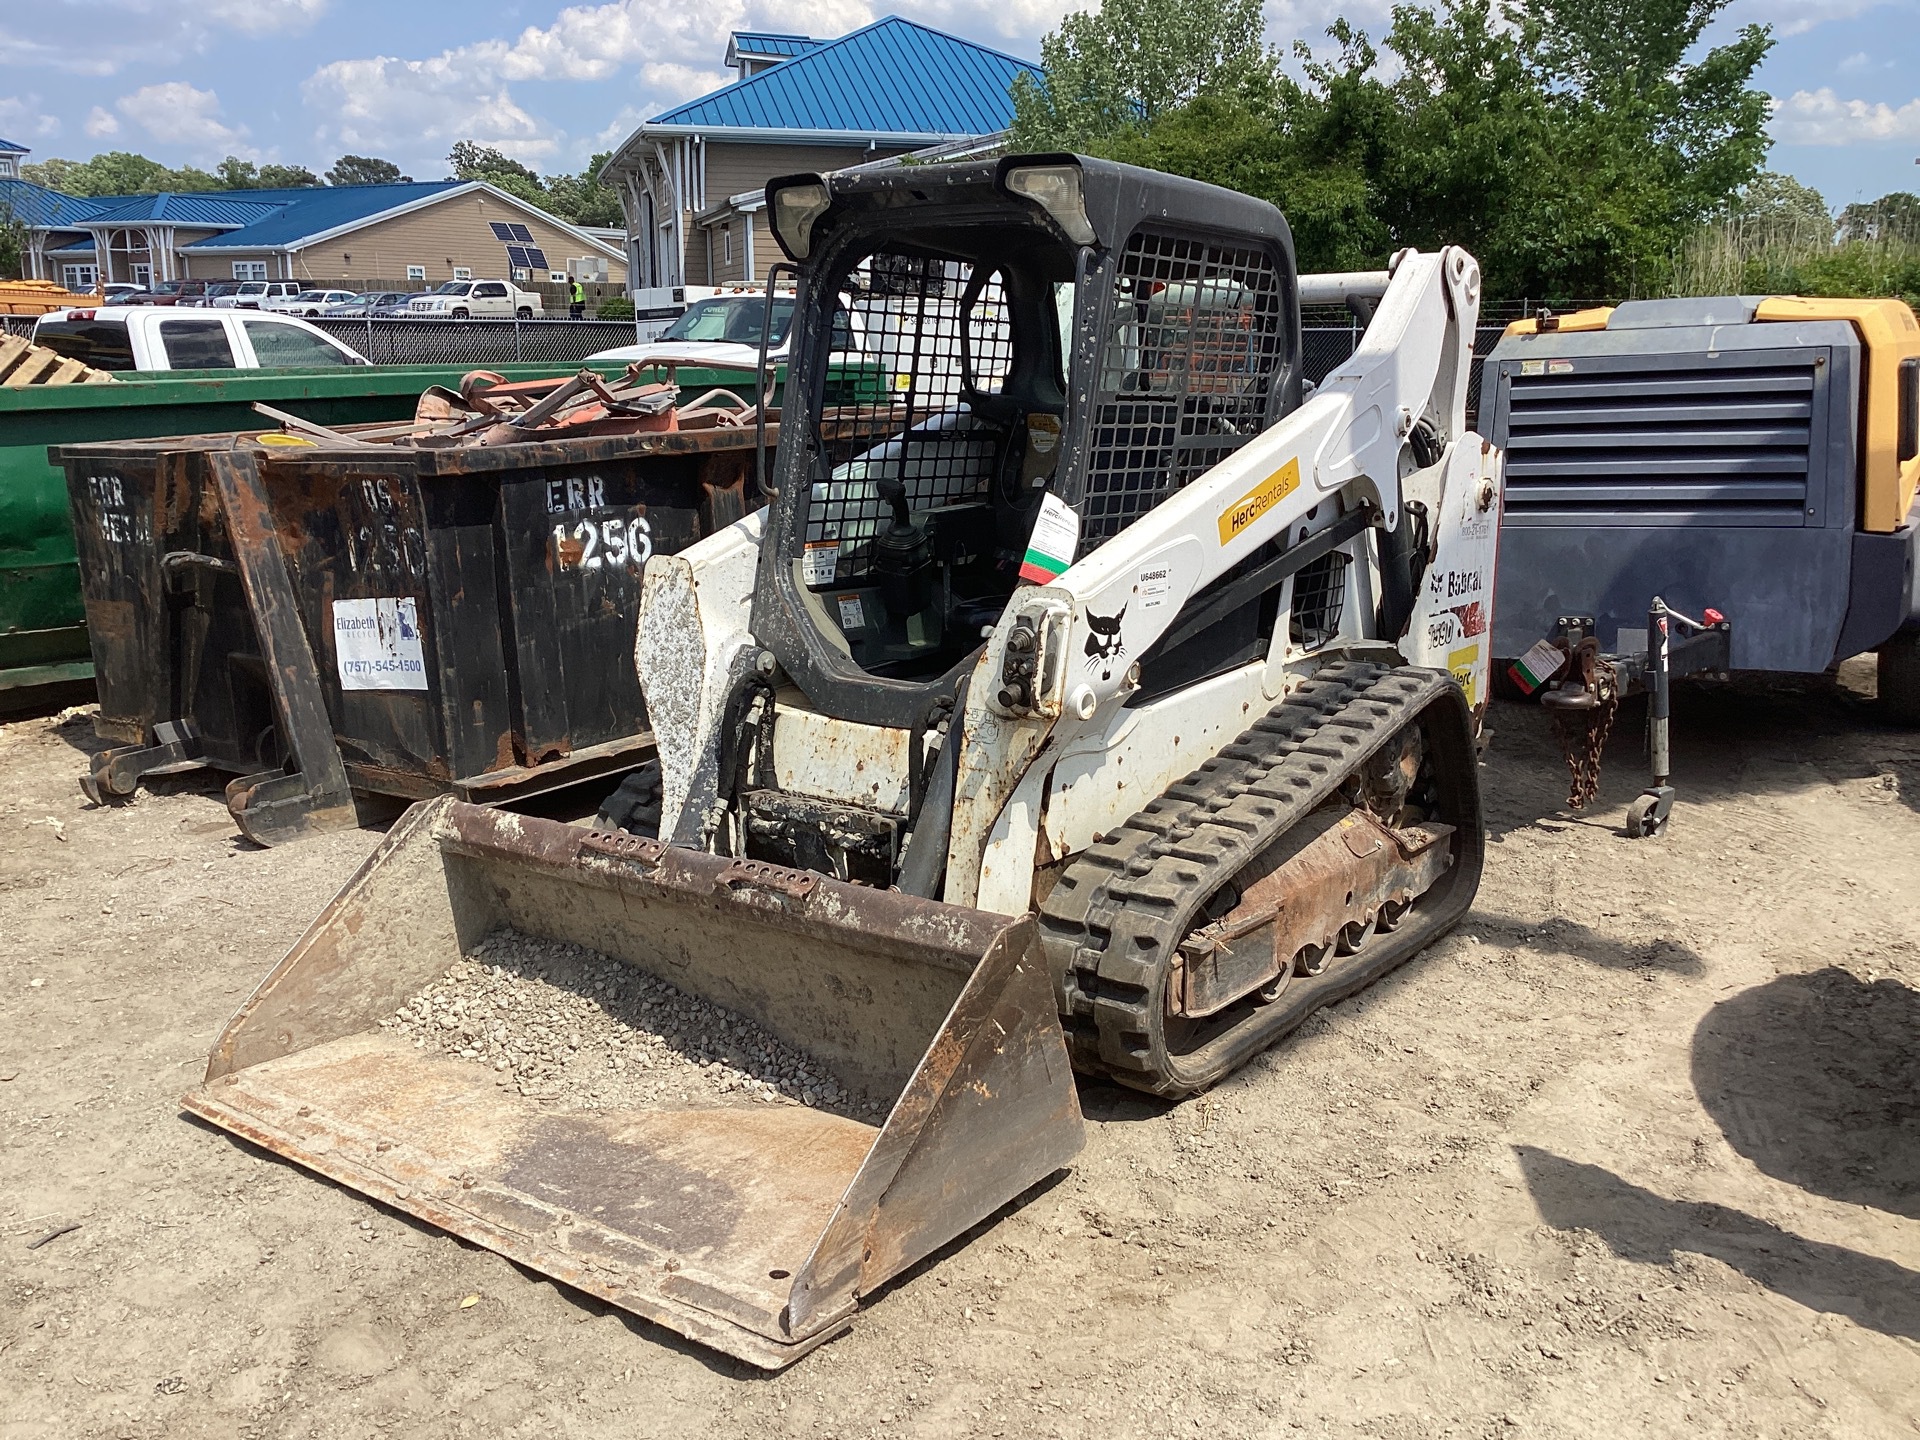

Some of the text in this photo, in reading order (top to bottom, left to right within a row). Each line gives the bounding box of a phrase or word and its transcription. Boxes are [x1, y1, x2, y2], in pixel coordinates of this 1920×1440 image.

[546, 476, 605, 513] ERR
[1231, 477, 1289, 533] HercRentals
[552, 517, 652, 573] 1256
[1447, 566, 1483, 598] Bobcat
[336, 615, 376, 630] Elizabeth
